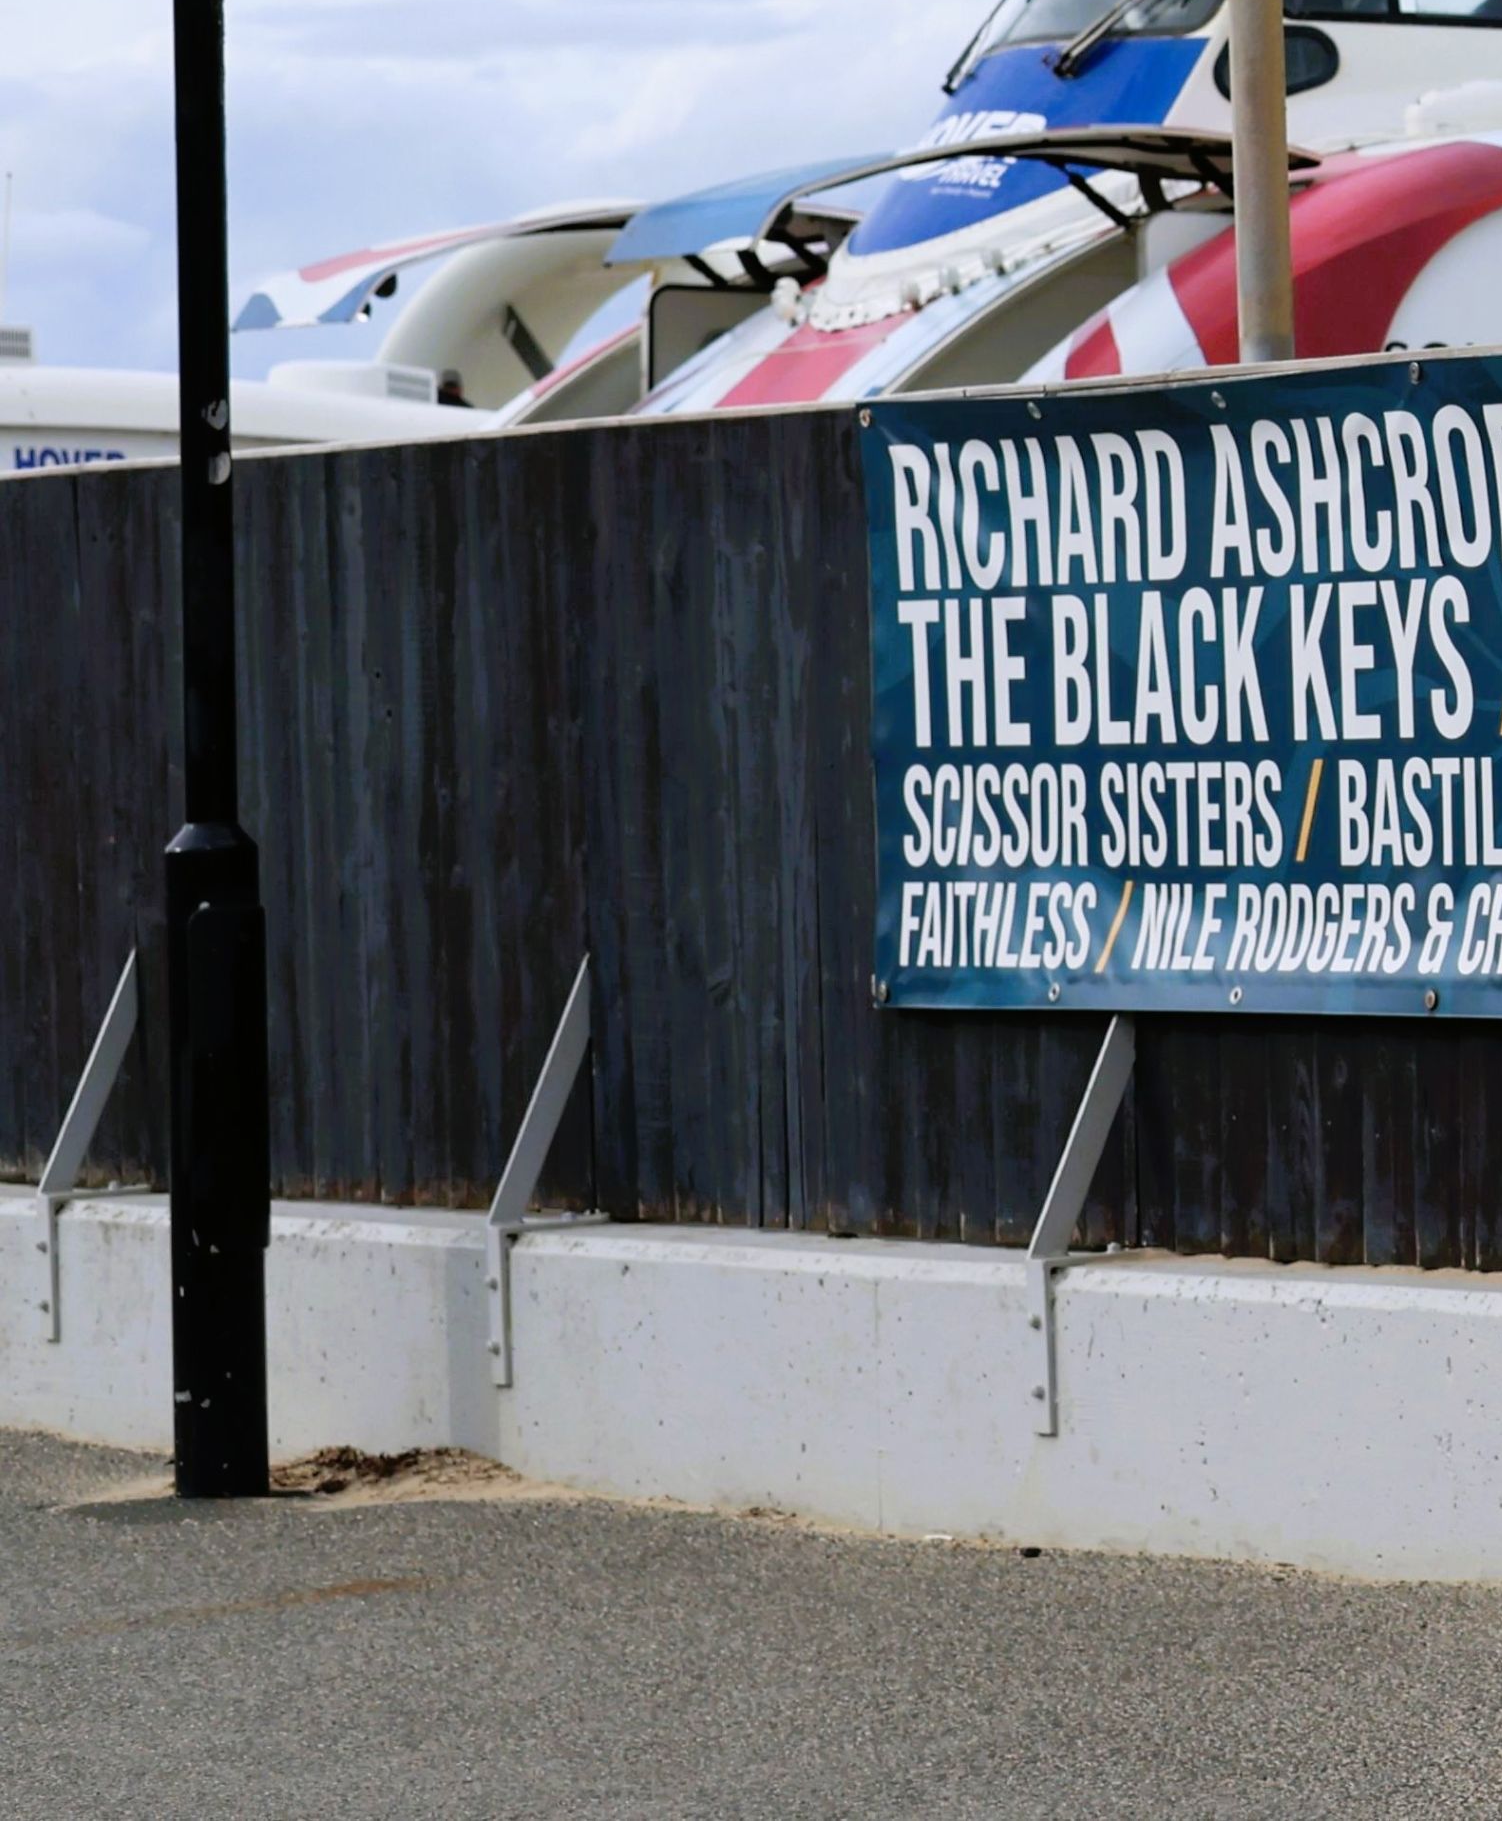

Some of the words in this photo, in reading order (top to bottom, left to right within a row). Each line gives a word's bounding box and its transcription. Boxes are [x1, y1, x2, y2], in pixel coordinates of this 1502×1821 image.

[888, 430, 1187, 592] RICHARD
[898, 596, 1031, 747] THE
[1052, 584, 1269, 745] BLACK
[1290, 575, 1473, 741] KEYS
[903, 763, 1088, 868] SCISSOR
[1100, 759, 1284, 868] SISTERS
[899, 881, 1097, 970] FAITHLESS
[1130, 882, 1228, 971] NILE
[1225, 882, 1417, 975] RODGERS
[1416, 882, 1455, 975] &
